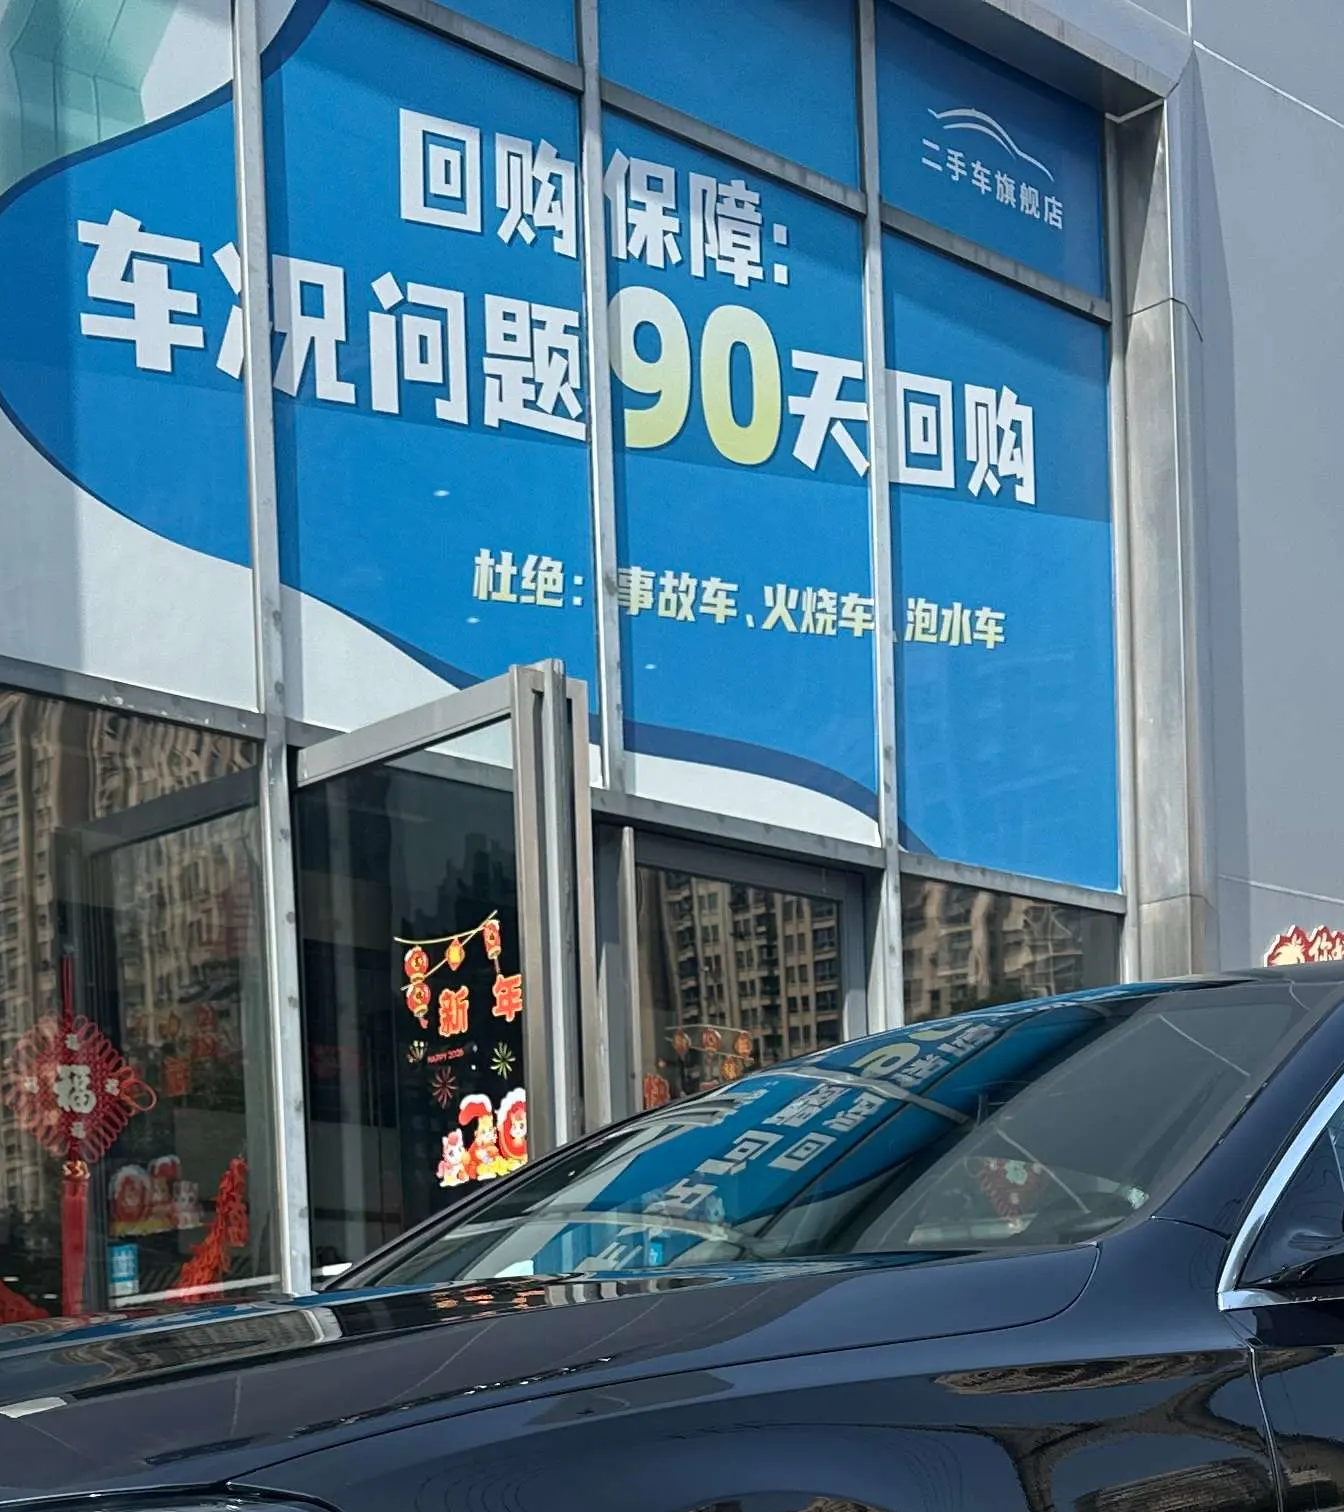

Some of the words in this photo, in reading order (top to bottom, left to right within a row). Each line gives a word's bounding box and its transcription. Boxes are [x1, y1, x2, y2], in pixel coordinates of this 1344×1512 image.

[400, 108, 789, 287] 回购保障：
[922, 138, 1063, 229] 二手车旗舰店
[77, 209, 1036, 504] 车况问题90天回购
